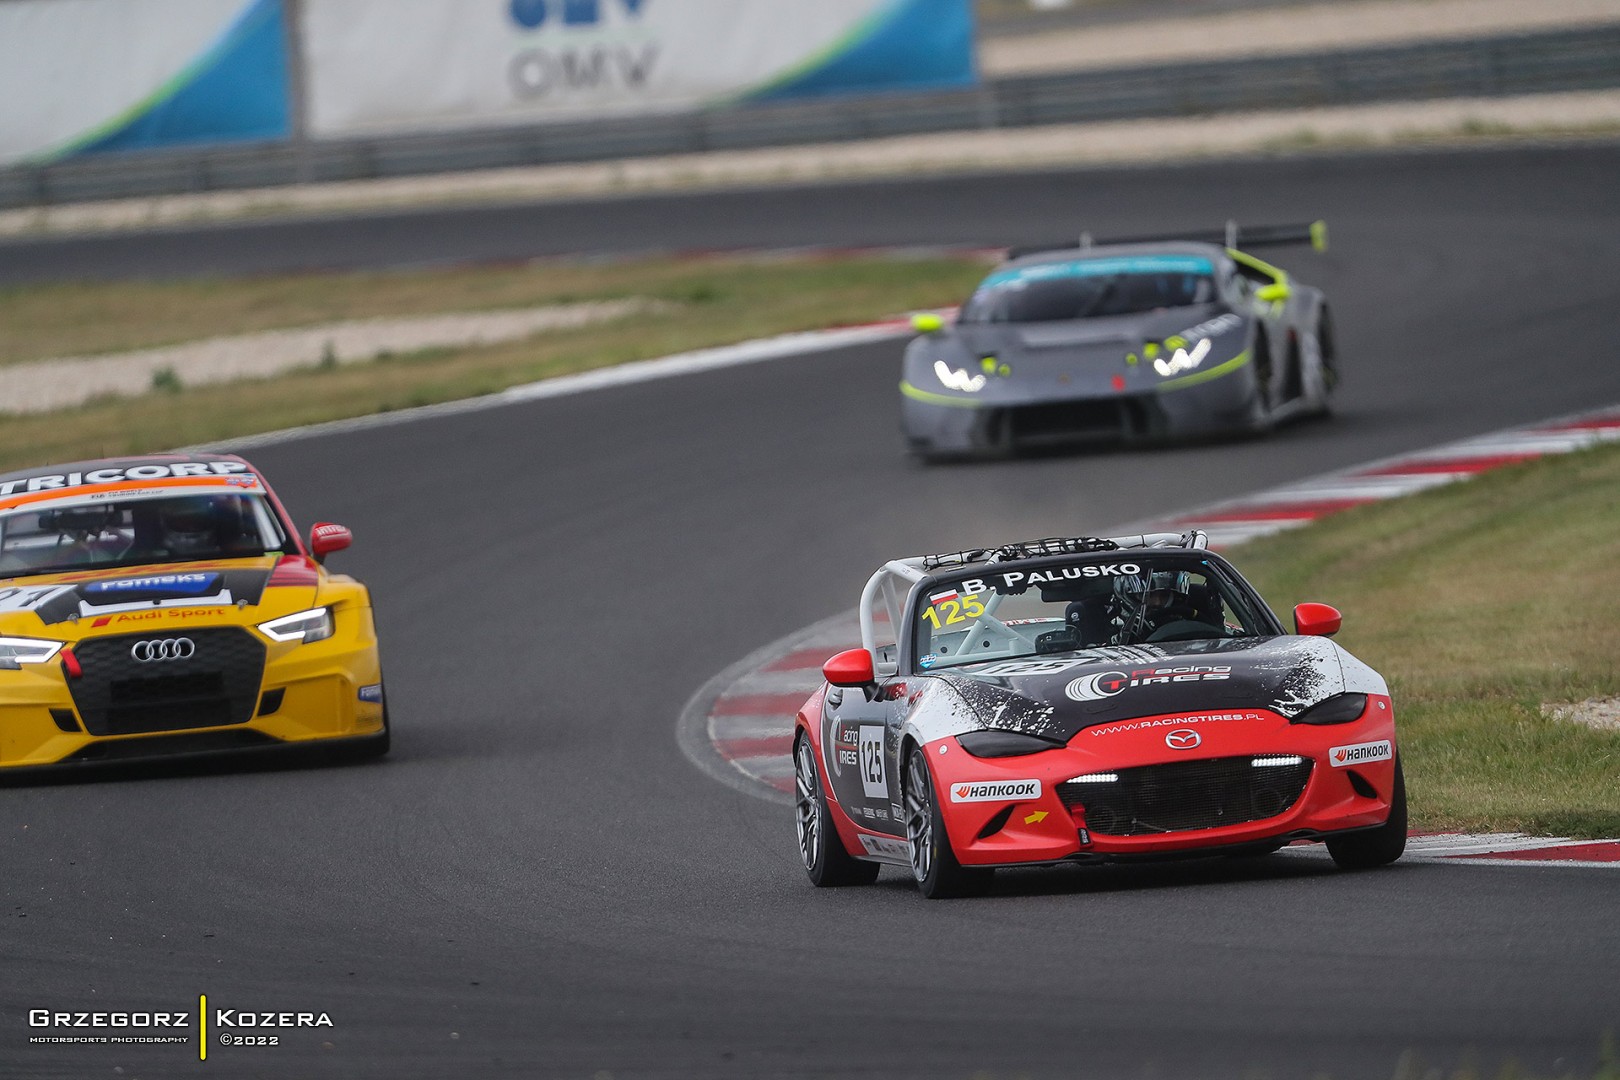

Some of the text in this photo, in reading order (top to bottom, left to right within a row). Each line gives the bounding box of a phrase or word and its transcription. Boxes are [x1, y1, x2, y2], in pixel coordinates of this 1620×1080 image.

[507, 46, 661, 96] OMV
[962, 578, 996, 597] B.
[1002, 563, 1141, 588] PALUSKO
[117, 608, 225, 623] Audi Sport
[921, 594, 985, 630] 125
[1091, 713, 1264, 737] WWW.RACINGTIRES.PL
[861, 741, 883, 783] 125
